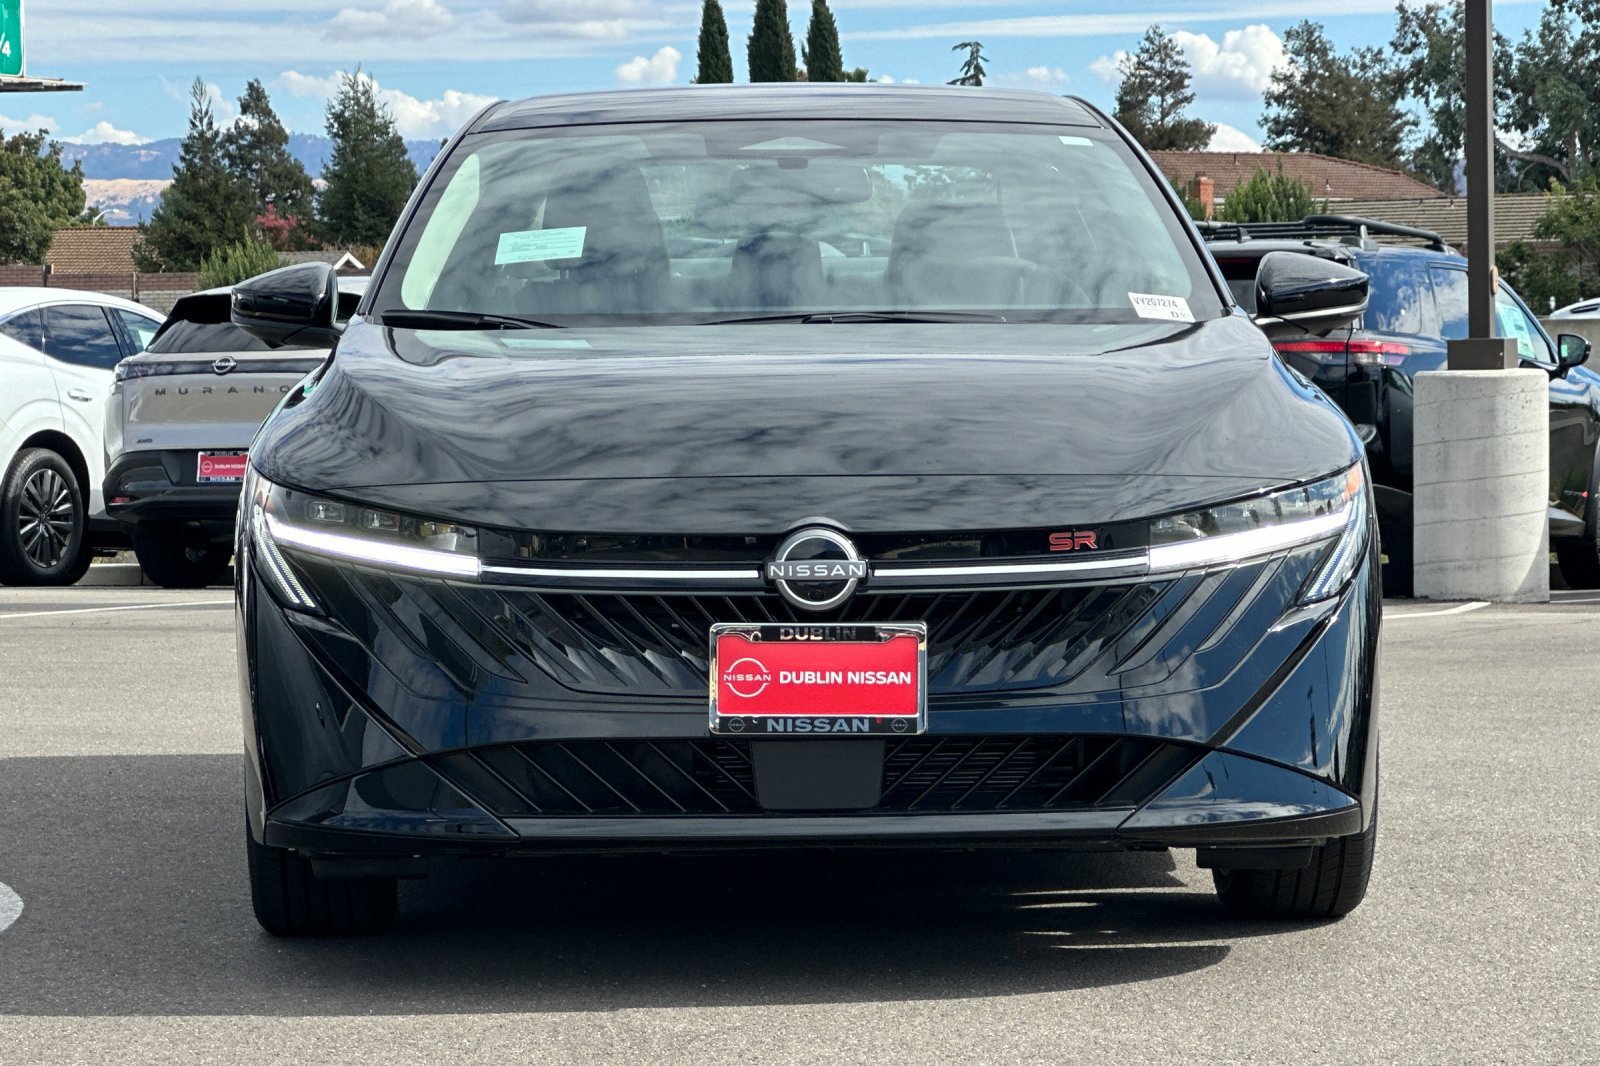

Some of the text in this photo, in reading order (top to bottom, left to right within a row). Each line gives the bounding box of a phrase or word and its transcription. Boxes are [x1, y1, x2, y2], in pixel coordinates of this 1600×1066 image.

[155, 386, 290, 396] MURANO
[1049, 531, 1098, 551] SR
[770, 564, 864, 577] NISSAN
[780, 626, 856, 641] DUBLIN
[779, 671, 911, 684] DUBLIN NISSAN
[767, 718, 869, 732] NISSAN
